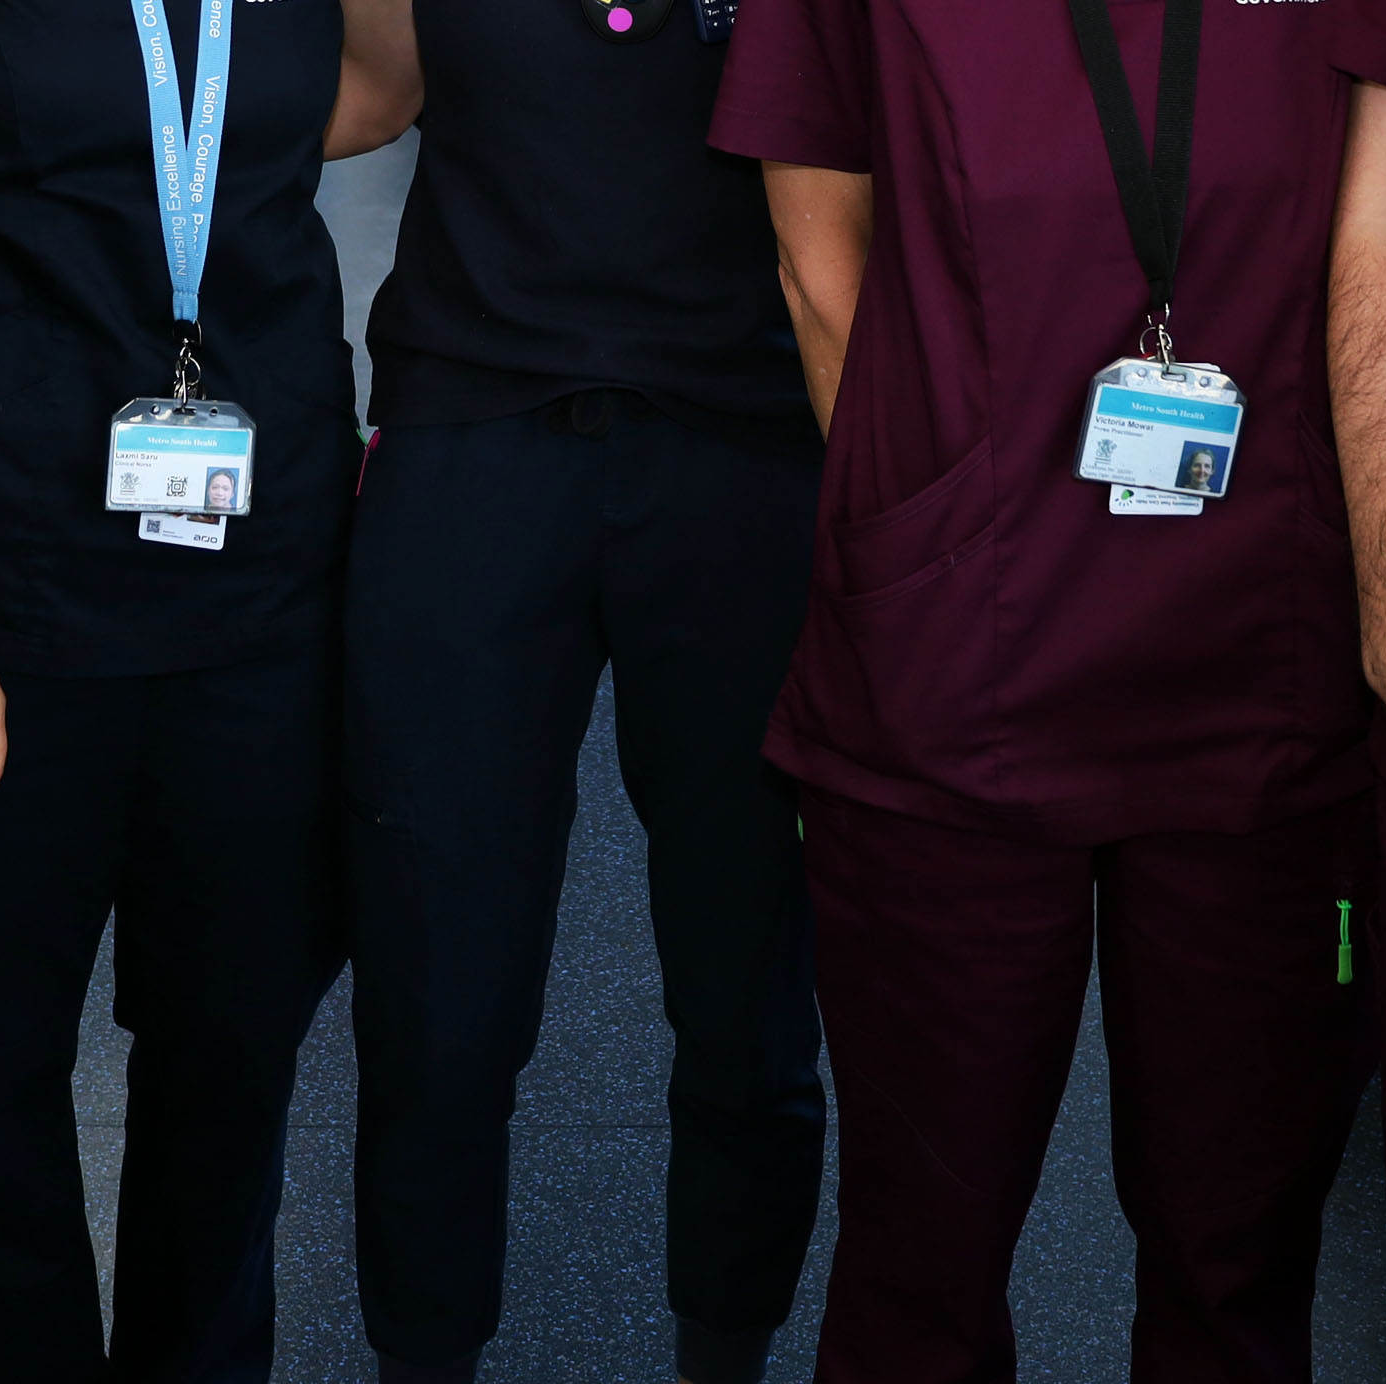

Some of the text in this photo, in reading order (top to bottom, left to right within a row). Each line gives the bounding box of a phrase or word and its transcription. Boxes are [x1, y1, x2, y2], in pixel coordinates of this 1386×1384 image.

[149, 31, 169, 87] Vision,
[198, 75, 222, 129] Vision,
[162, 124, 188, 277] Nursing Excellence
[1131, 401, 1205, 421] Metro South Health
[1095, 416, 1154, 432] Victoria Mowat
[147, 436, 218, 447] Metro South Health
[115, 452, 139, 460] Laxmi
